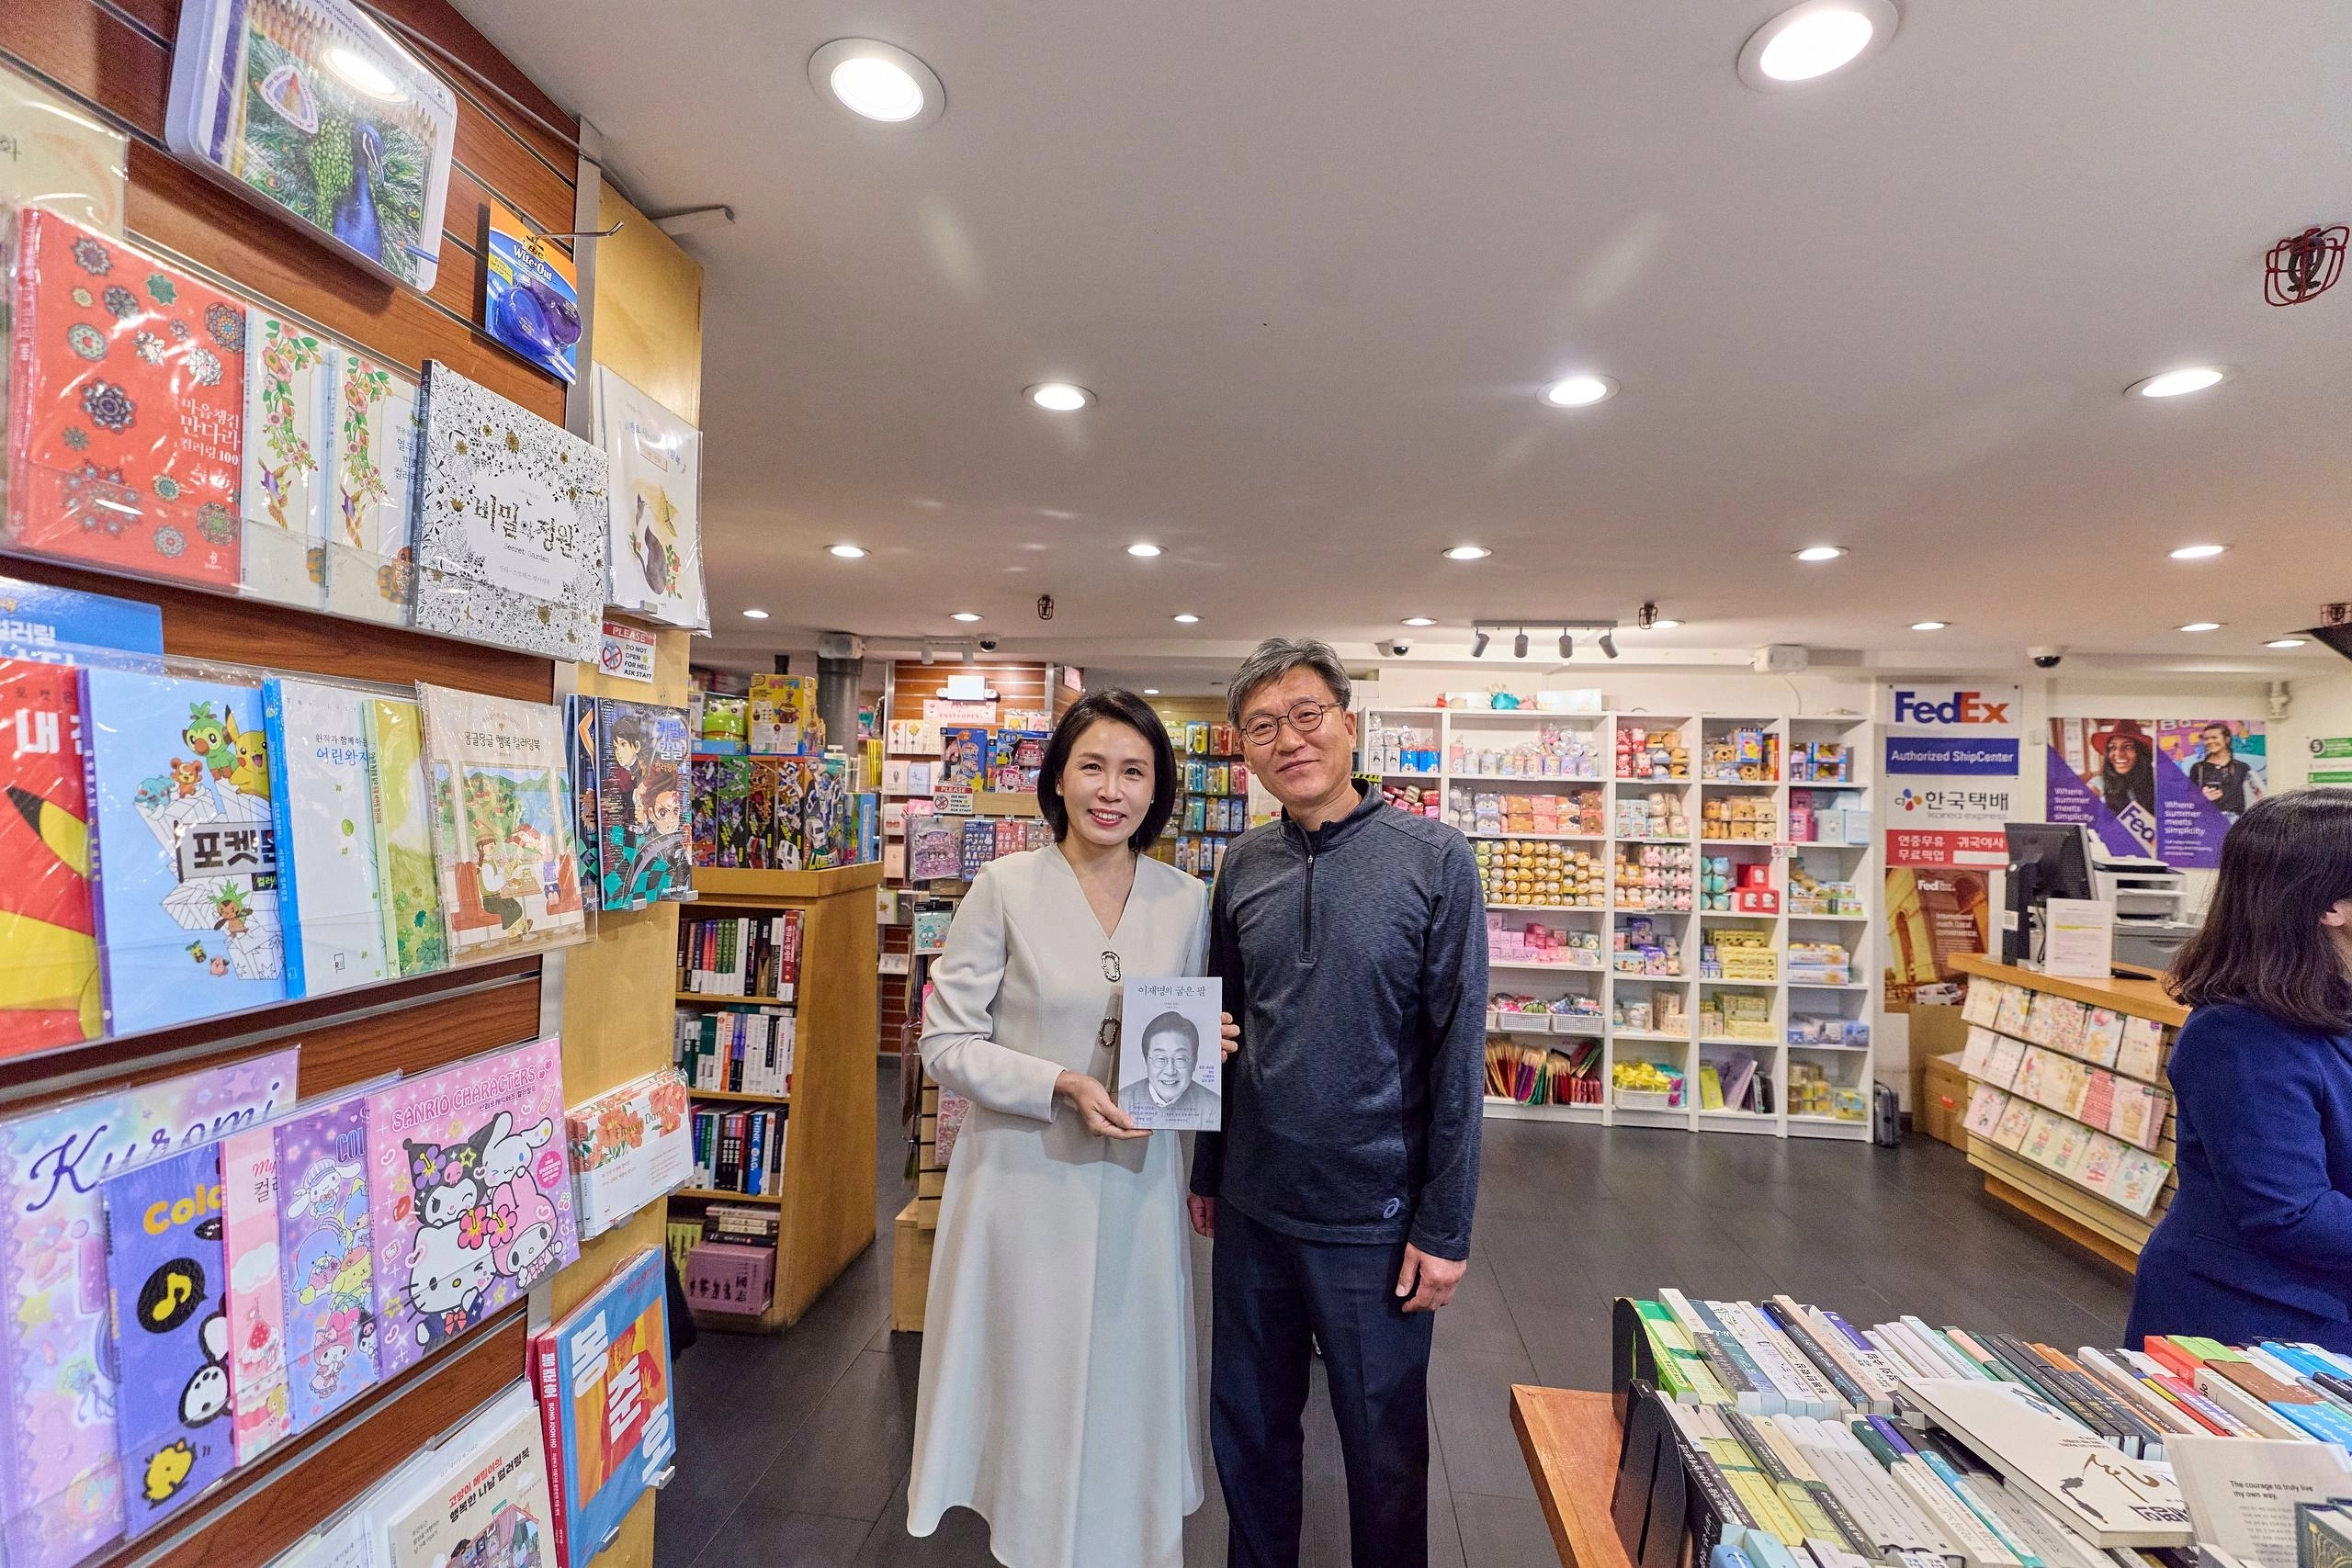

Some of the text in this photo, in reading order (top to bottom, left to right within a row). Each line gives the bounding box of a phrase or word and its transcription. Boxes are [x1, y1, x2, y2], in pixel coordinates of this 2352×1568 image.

[182, 398, 240, 430] 마음챙김
[180, 414, 241, 451] 만다라
[180, 436, 239, 465] 컬러링 100
[474, 494, 574, 559] 비밀의 정원
[503, 543, 550, 563] Secret Garden
[612, 626, 646, 642] PLEASE
[1895, 691, 2009, 725] FedEx
[15, 707, 60, 754] 내
[316, 733, 338, 745] 원작과
[496, 735, 510, 749] 행복
[513, 737, 540, 750] 컬러링북
[660, 740, 685, 761] 칼날
[1891, 750, 2014, 764] Authorized ShipCenter
[1925, 791, 2009, 811] 한국택배
[2054, 787, 2083, 795] Where
[2165, 801, 2195, 809] Where
[1898, 835, 2004, 848] 연중무휴 귀국이사
[1898, 849, 1944, 862] 무료픽업
[1138, 985, 1172, 997] 이재명의
[1175, 986, 1195, 998] 굽은
[392, 1066, 536, 1132] SANRIO CHARACTERS
[615, 1121, 644, 1140] Flower
[752, 1116, 762, 1143] THINK
[27, 1082, 280, 1213] Kuromi
[571, 1309, 609, 1398] 봉
[608, 1355, 642, 1445] 준
[548, 1420, 557, 1438] JOON
[551, 1438, 558, 1449] HO
[641, 1401, 672, 1484] 호
[448, 1481, 472, 1509] 고양이
[450, 1447, 530, 1523] 행복한 나날 컬러링북
[2230, 1480, 2244, 1489] The
[2245, 1482, 2273, 1491] courage
[2282, 1483, 2300, 1492] truly
